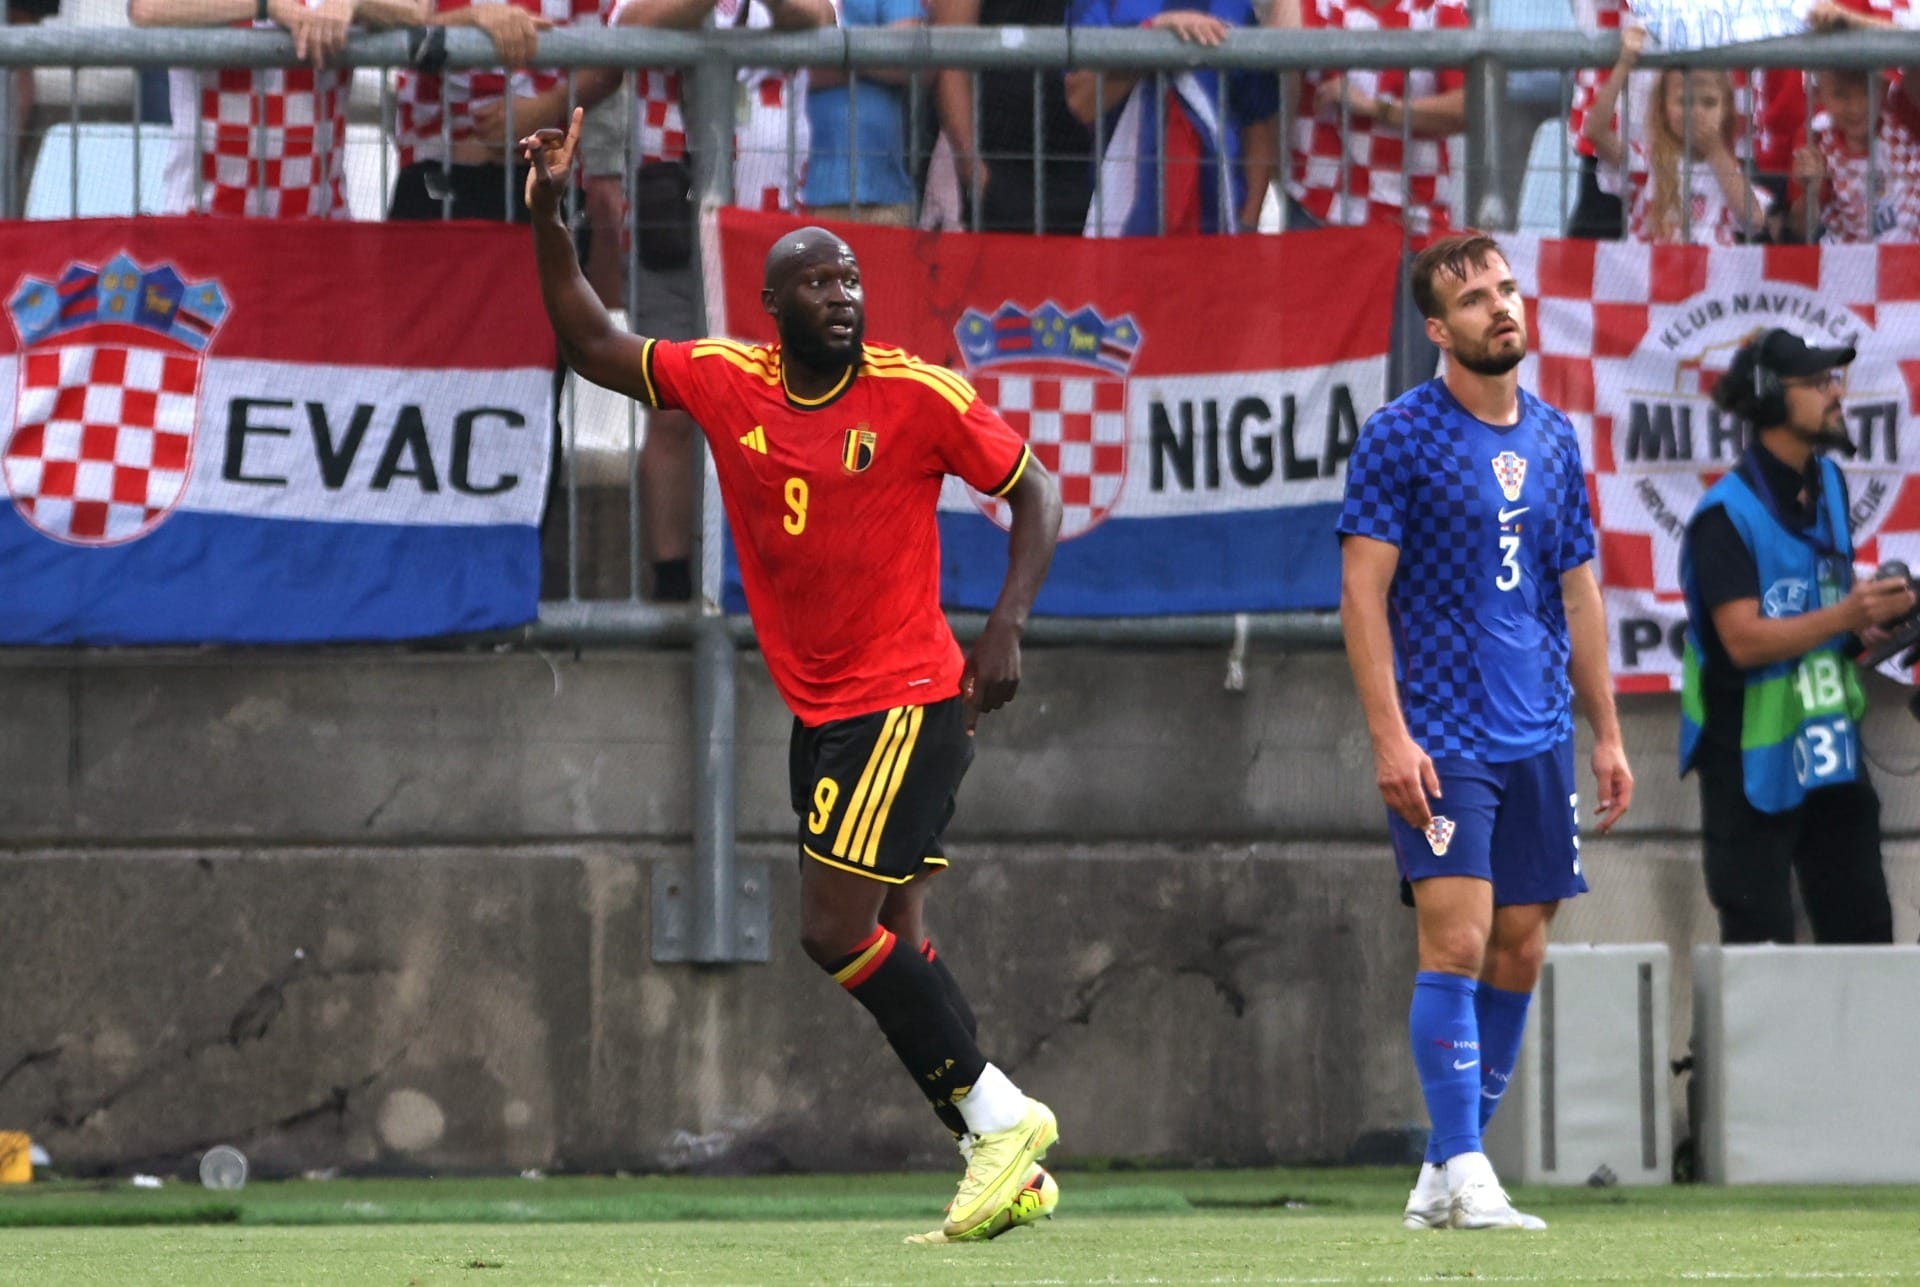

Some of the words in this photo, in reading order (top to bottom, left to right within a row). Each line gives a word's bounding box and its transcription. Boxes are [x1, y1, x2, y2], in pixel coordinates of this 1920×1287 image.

[1660, 300, 1723, 350] KLUB
[222, 396, 526, 496] EVAC
[1149, 383, 1360, 492] NIGLA
[1624, 401, 1692, 462] MI
[1707, 401, 1899, 463] HTI
[783, 477, 809, 536] 9
[1495, 536, 1521, 592] 3
[808, 776, 840, 835] 9
